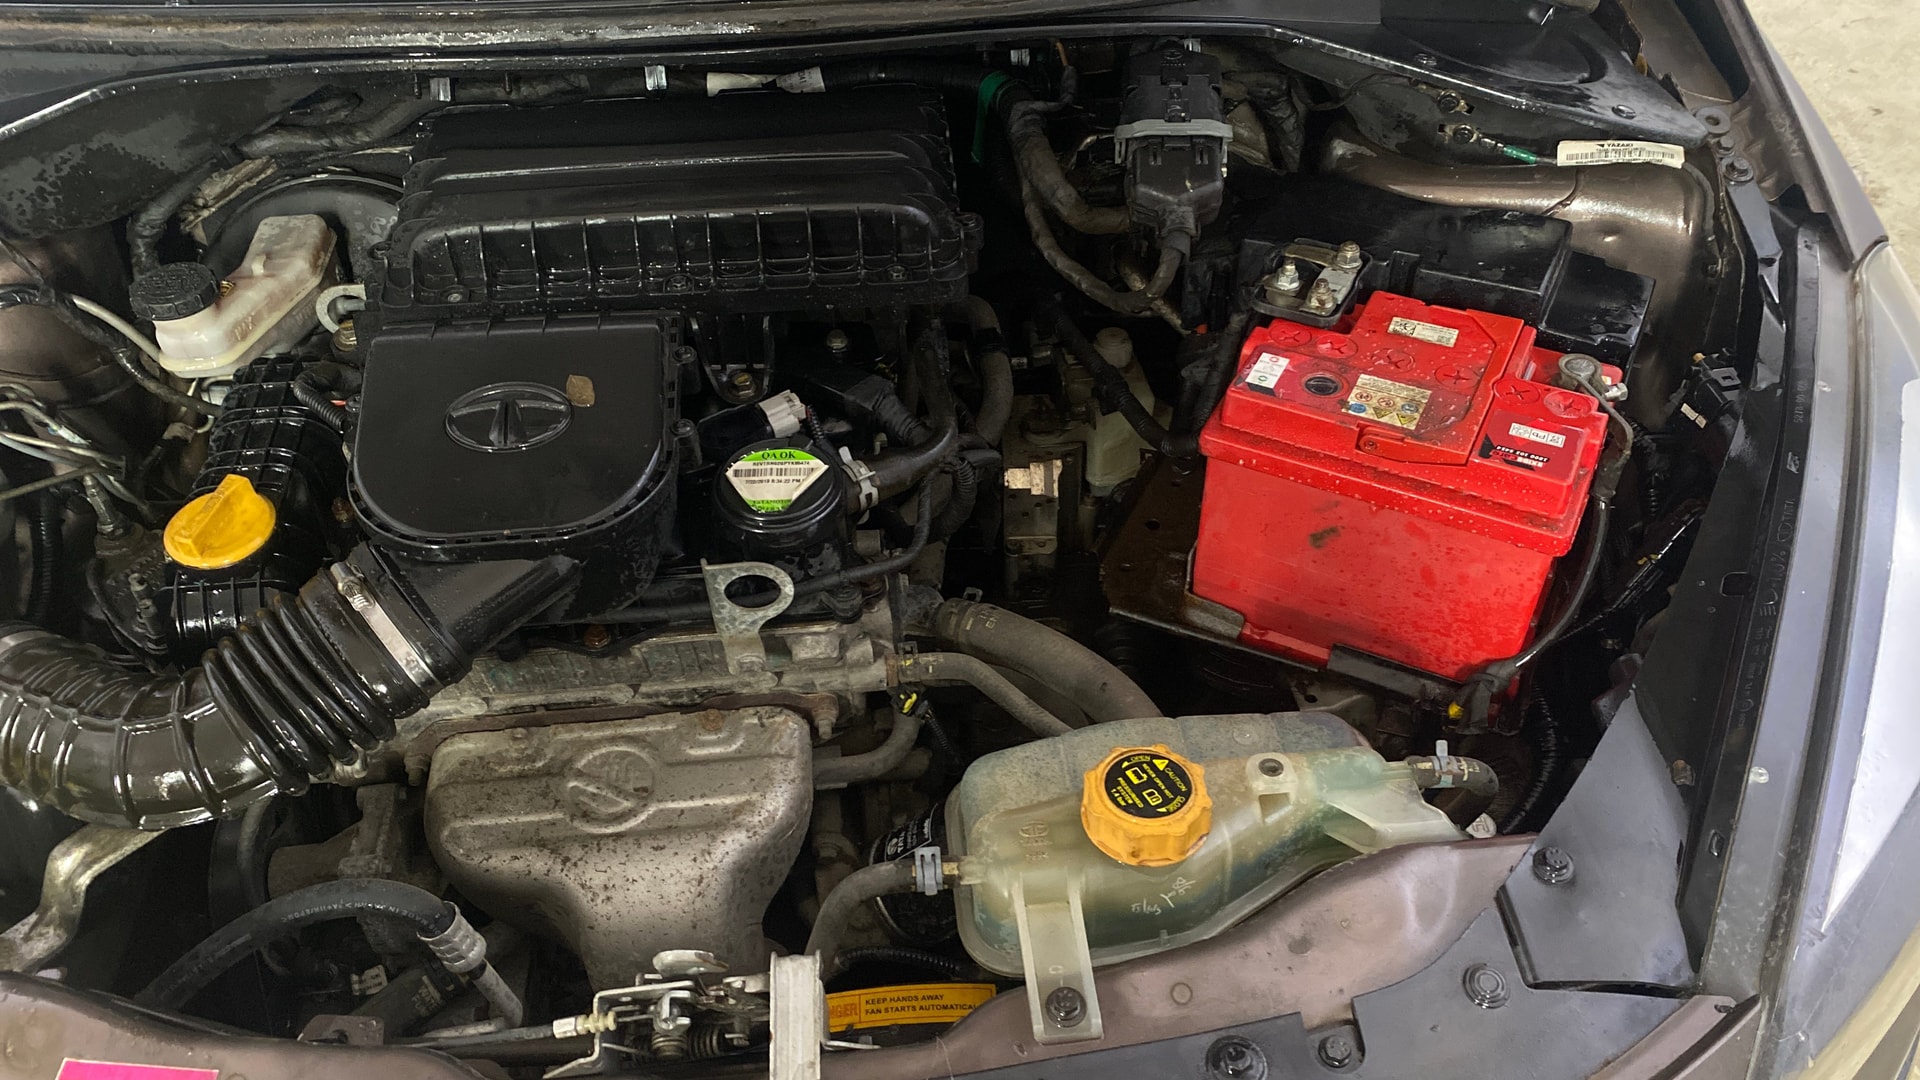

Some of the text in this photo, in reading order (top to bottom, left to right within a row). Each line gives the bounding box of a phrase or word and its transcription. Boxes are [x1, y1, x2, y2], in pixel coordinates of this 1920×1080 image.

[762, 451, 797, 460] QA OK
[1142, 763, 1156, 778] NEVER
[1153, 777, 1165, 789] OPEN
[1164, 767, 1188, 792] CAUTION
[865, 994, 945, 1006] KEEP HANDS AWAY
[865, 1008, 882, 1016] FAN
[884, 1005, 917, 1014] STARTS
